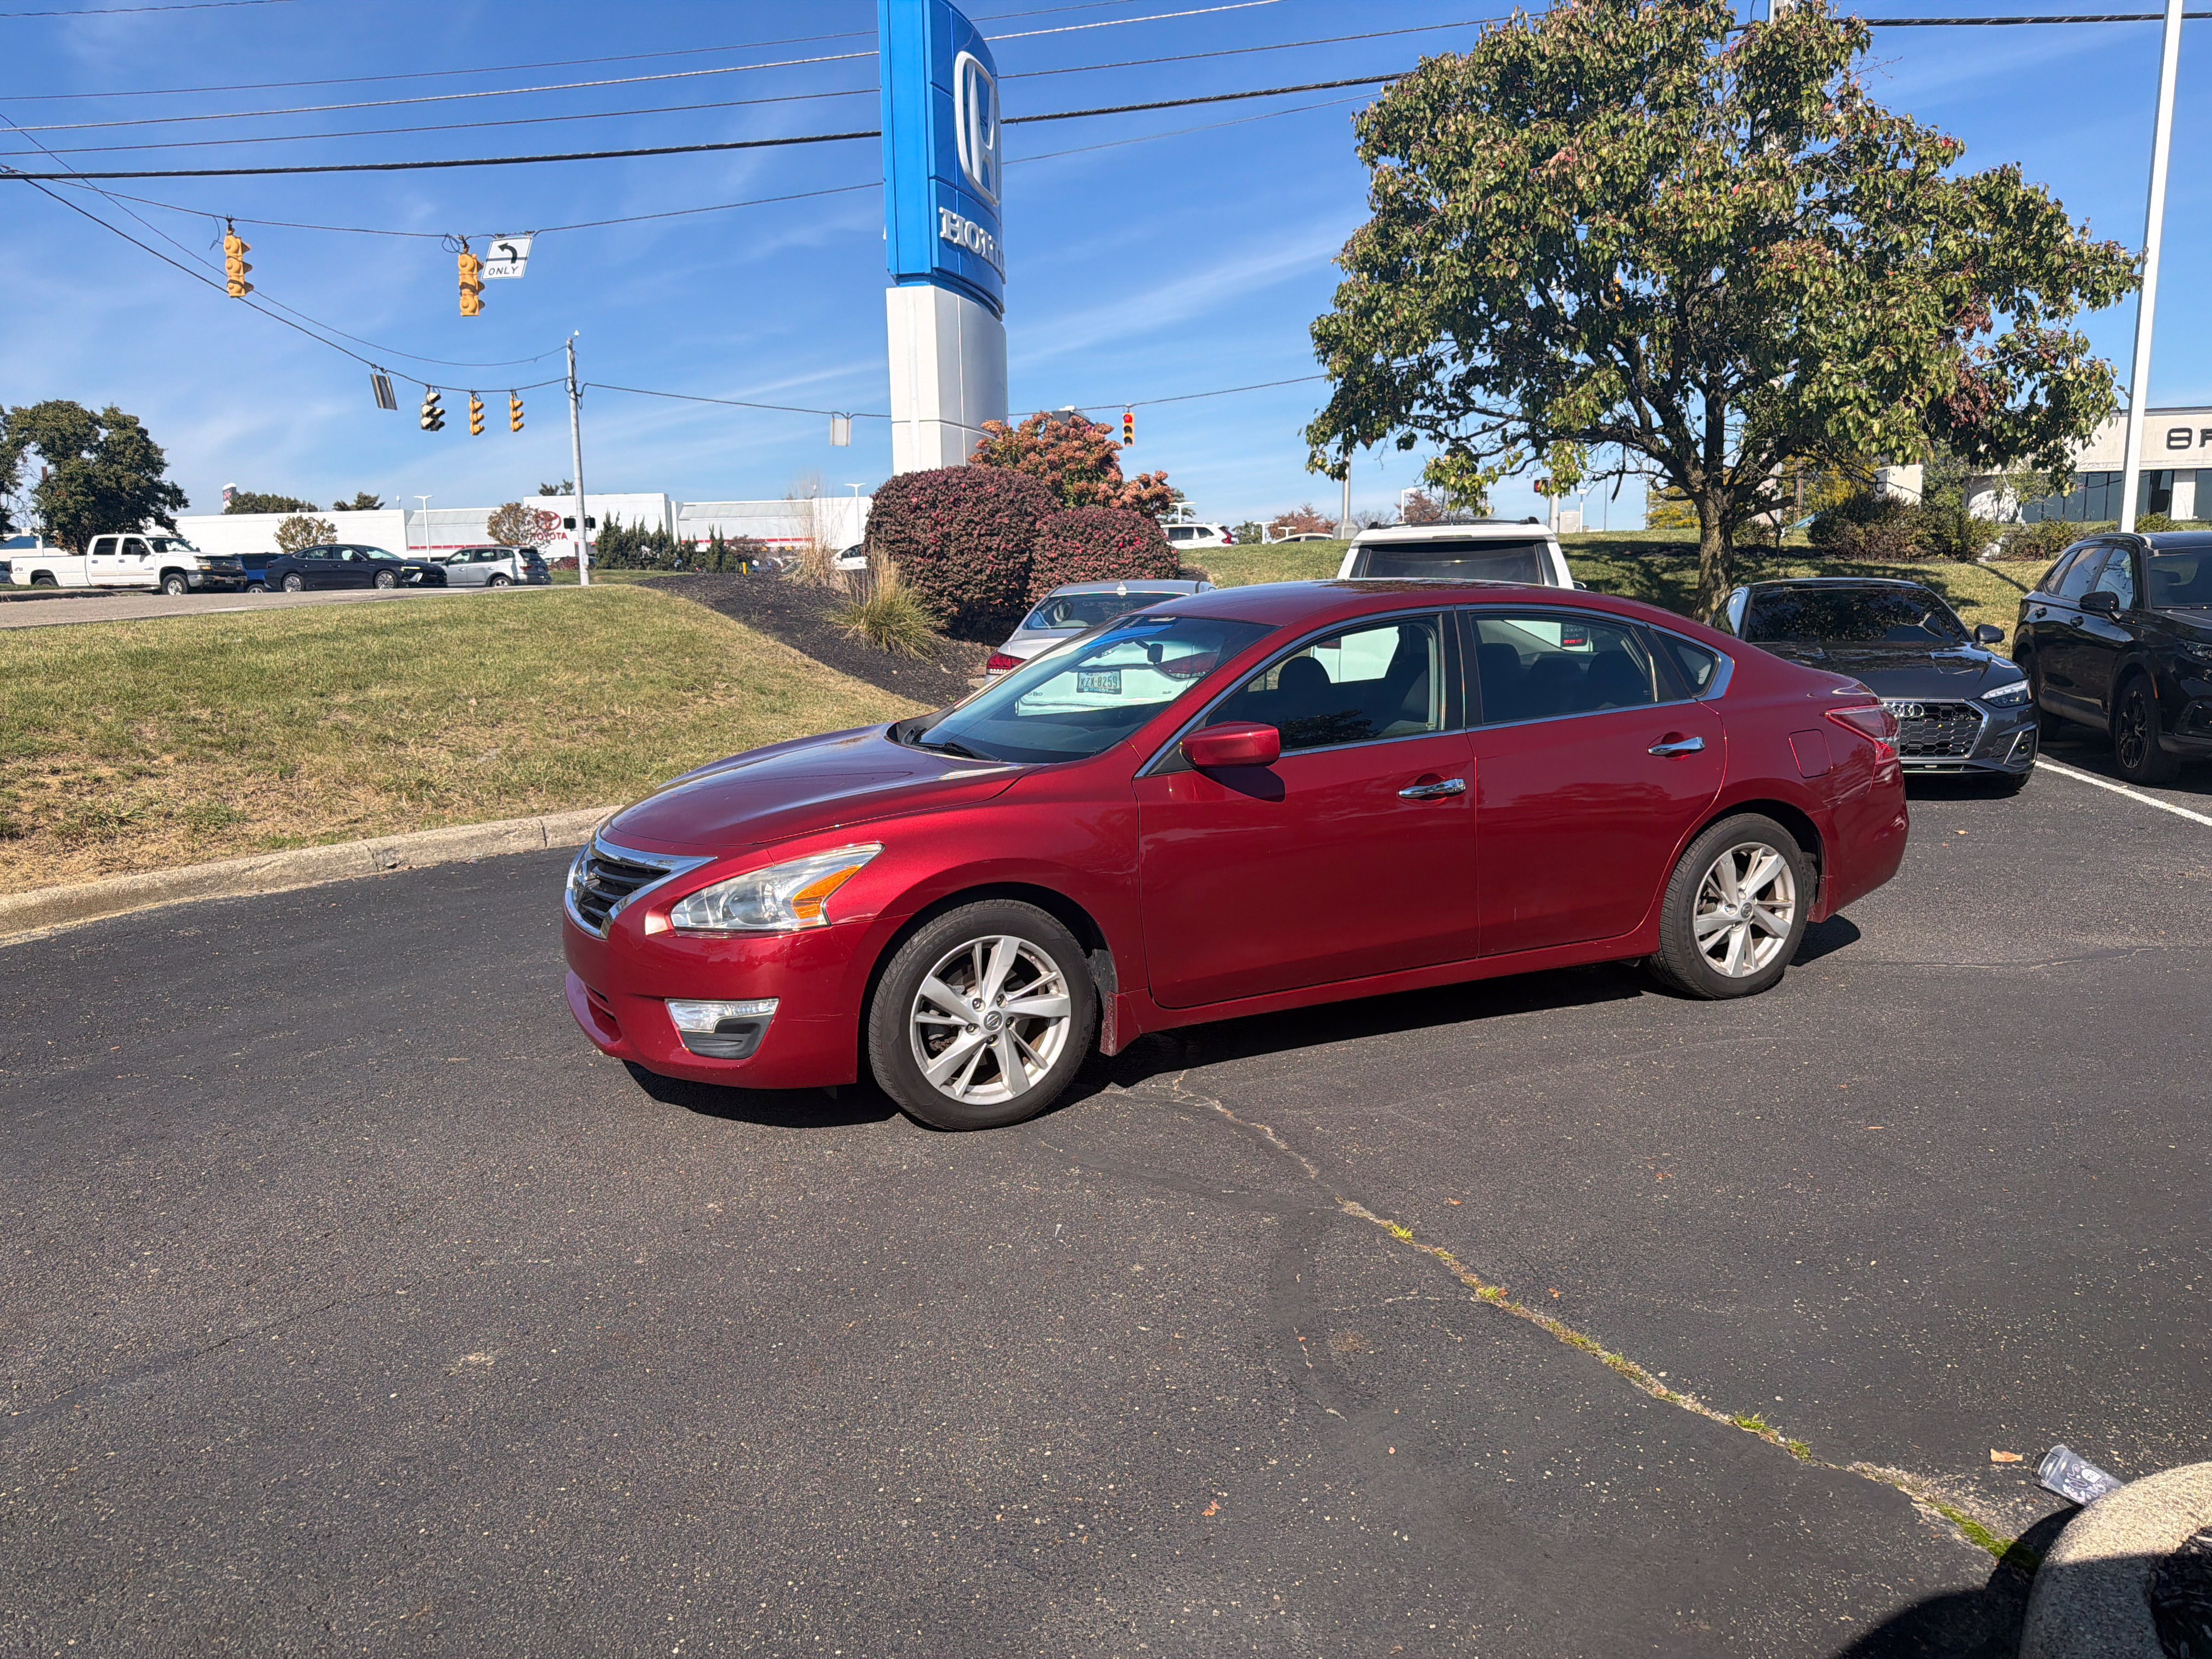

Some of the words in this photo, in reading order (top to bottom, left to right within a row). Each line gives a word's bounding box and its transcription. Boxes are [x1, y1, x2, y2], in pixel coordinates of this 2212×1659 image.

[489, 266, 518, 275] ONLY
[531, 532, 568, 540] TOYOTA
[1097, 676, 1118, 688] 8259
